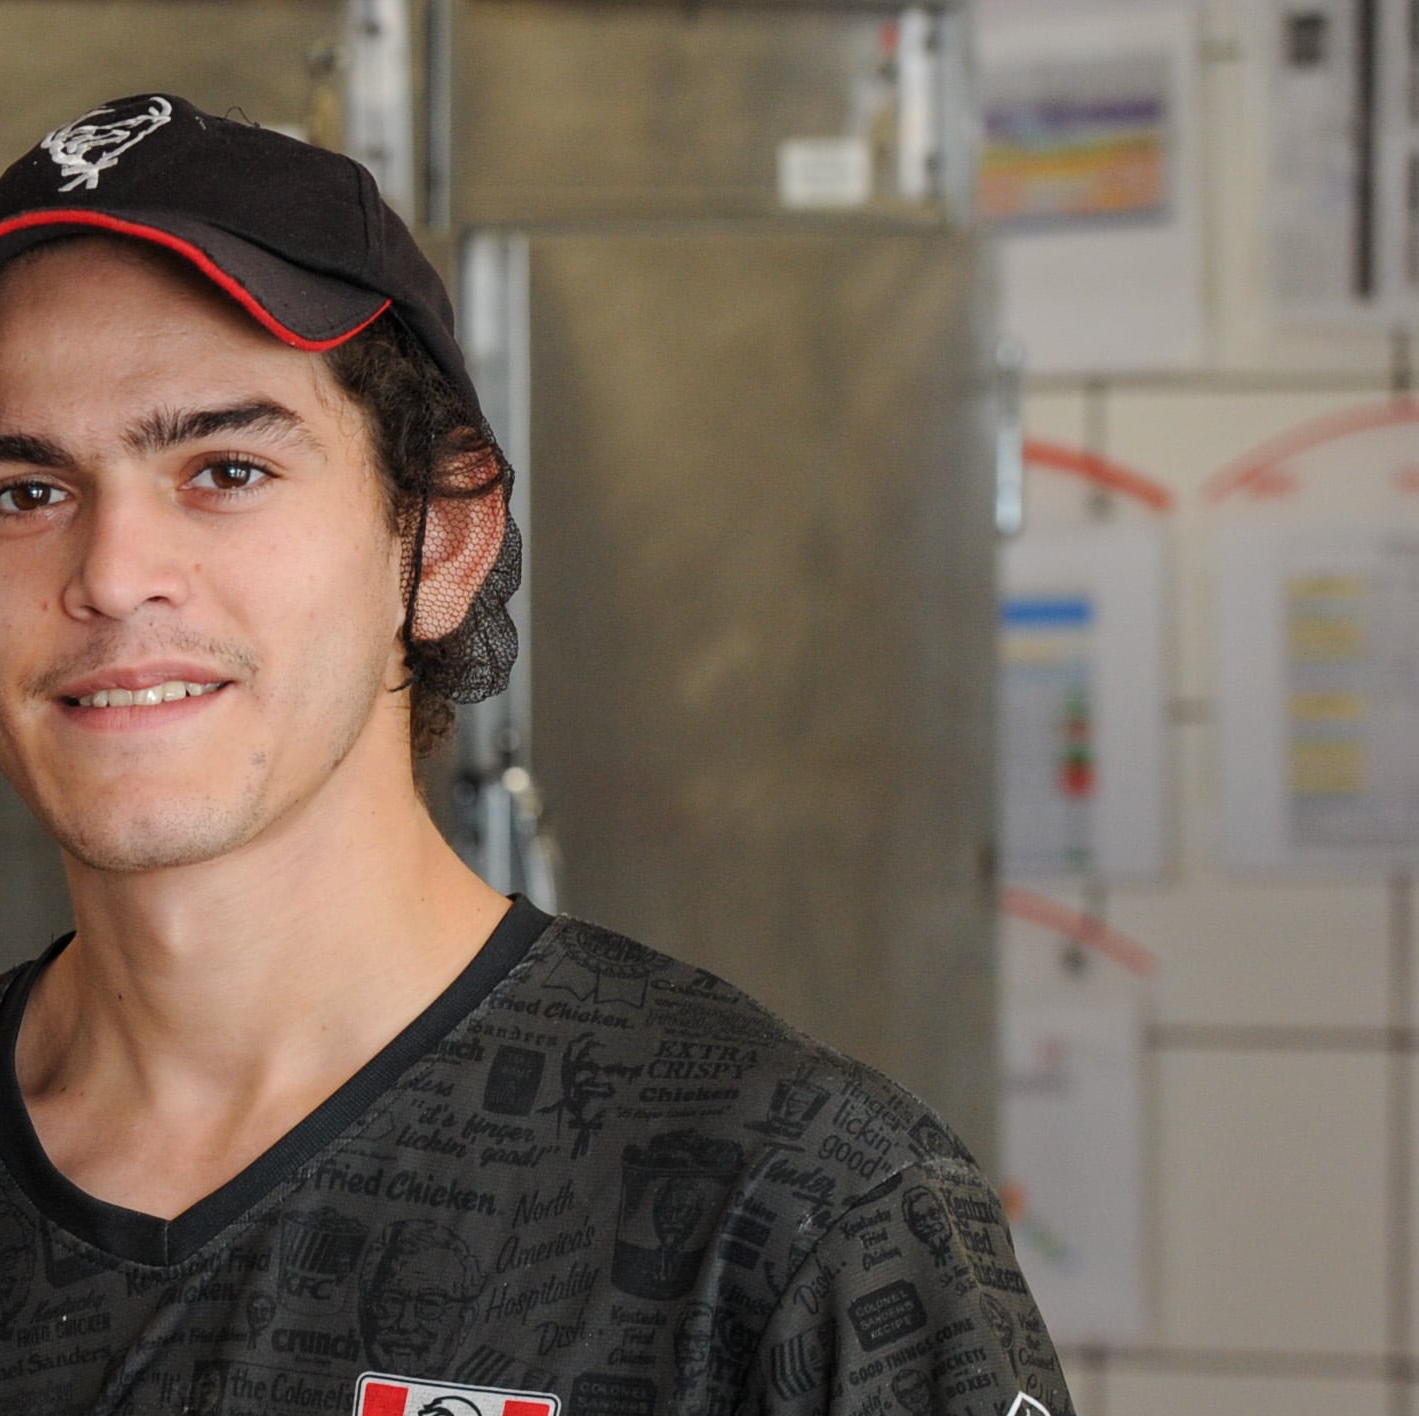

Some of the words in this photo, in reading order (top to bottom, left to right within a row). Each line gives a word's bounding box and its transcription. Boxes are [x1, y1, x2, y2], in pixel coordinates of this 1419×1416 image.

[646, 1059, 757, 1081] CRISPY
[653, 1039, 759, 1064] EXTRA
[638, 1086, 741, 1104] Chicken
[311, 1157, 385, 1197] Fried
[384, 1168, 506, 1221] Chicken.
[510, 1178, 576, 1229] North
[495, 1214, 596, 1274] America's
[483, 1261, 600, 1327] Hospitality
[26, 1344, 114, 1376] Sanders
[271, 1327, 361, 1366] crunch
[229, 1367, 267, 1404] the
[578, 1381, 648, 1399] COLONEL
